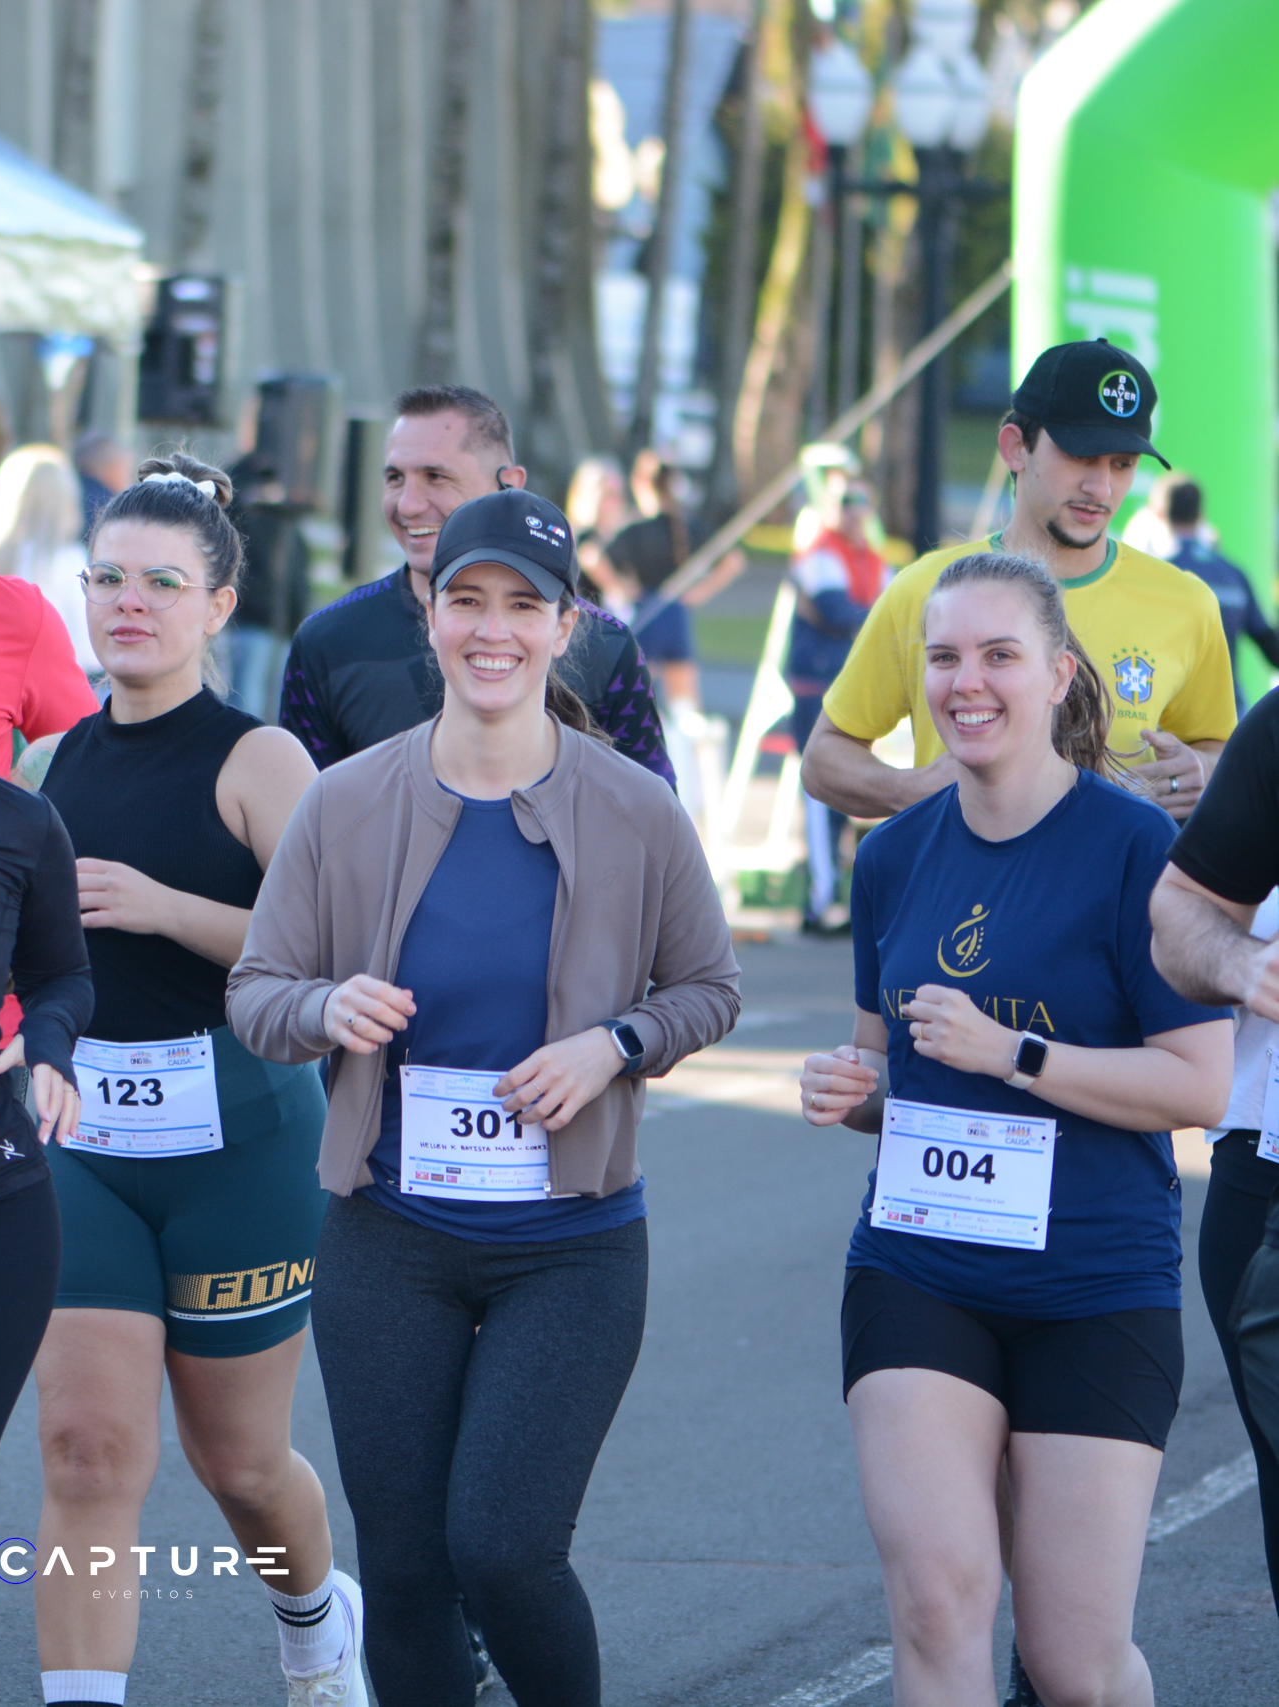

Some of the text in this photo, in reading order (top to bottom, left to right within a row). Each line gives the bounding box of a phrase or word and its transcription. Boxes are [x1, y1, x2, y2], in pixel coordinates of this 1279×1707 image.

[1103, 388, 1136, 402] BAYER
[1117, 375, 1126, 414] BAYER
[1117, 709, 1147, 720] BRASIL
[168, 1058, 191, 1066] CAUSA
[97, 1077, 164, 1107] 123
[450, 1107, 523, 1140] 301
[461, 1144, 491, 1152] BATISTA
[1005, 1137, 1031, 1146] CAUSA
[922, 1146, 995, 1184] 004
[207, 1257, 316, 1306] FITN
